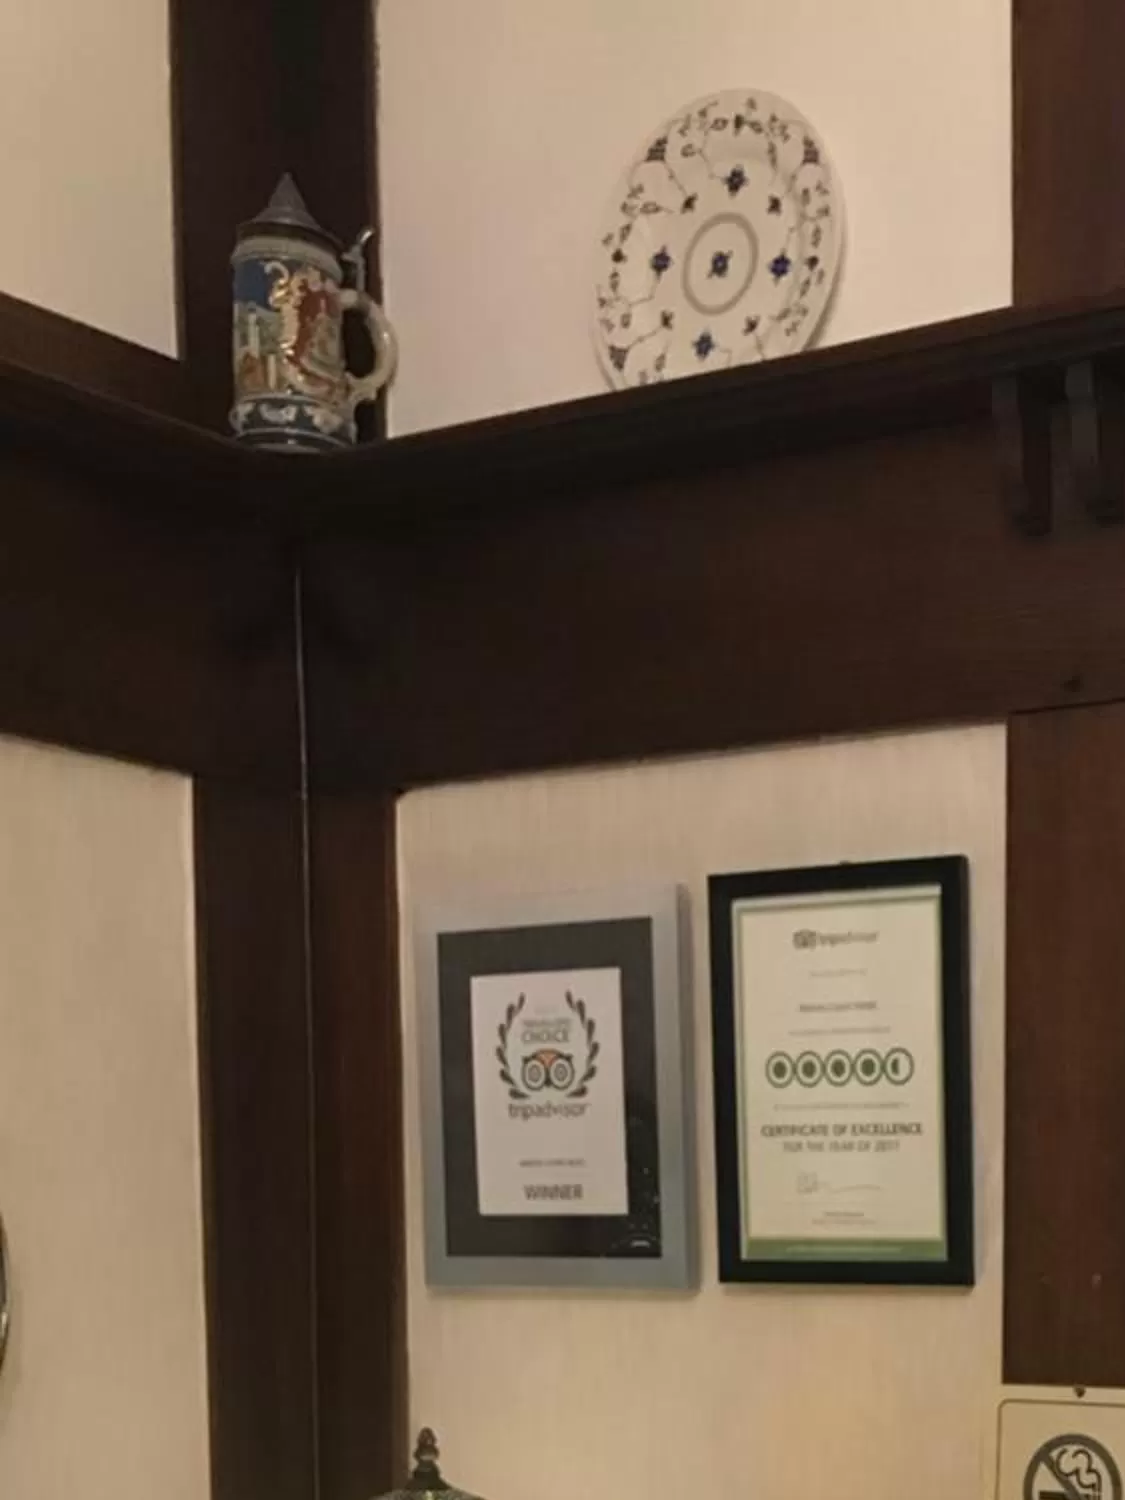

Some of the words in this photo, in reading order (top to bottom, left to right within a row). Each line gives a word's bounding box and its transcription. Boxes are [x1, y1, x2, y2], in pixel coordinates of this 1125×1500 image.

[508, 1101, 587, 1122] tripadvisor
[760, 1122, 829, 1138] CERTIFICATE
[851, 1120, 923, 1137] EXCELLENCE
[524, 1183, 584, 1201] WINNER
